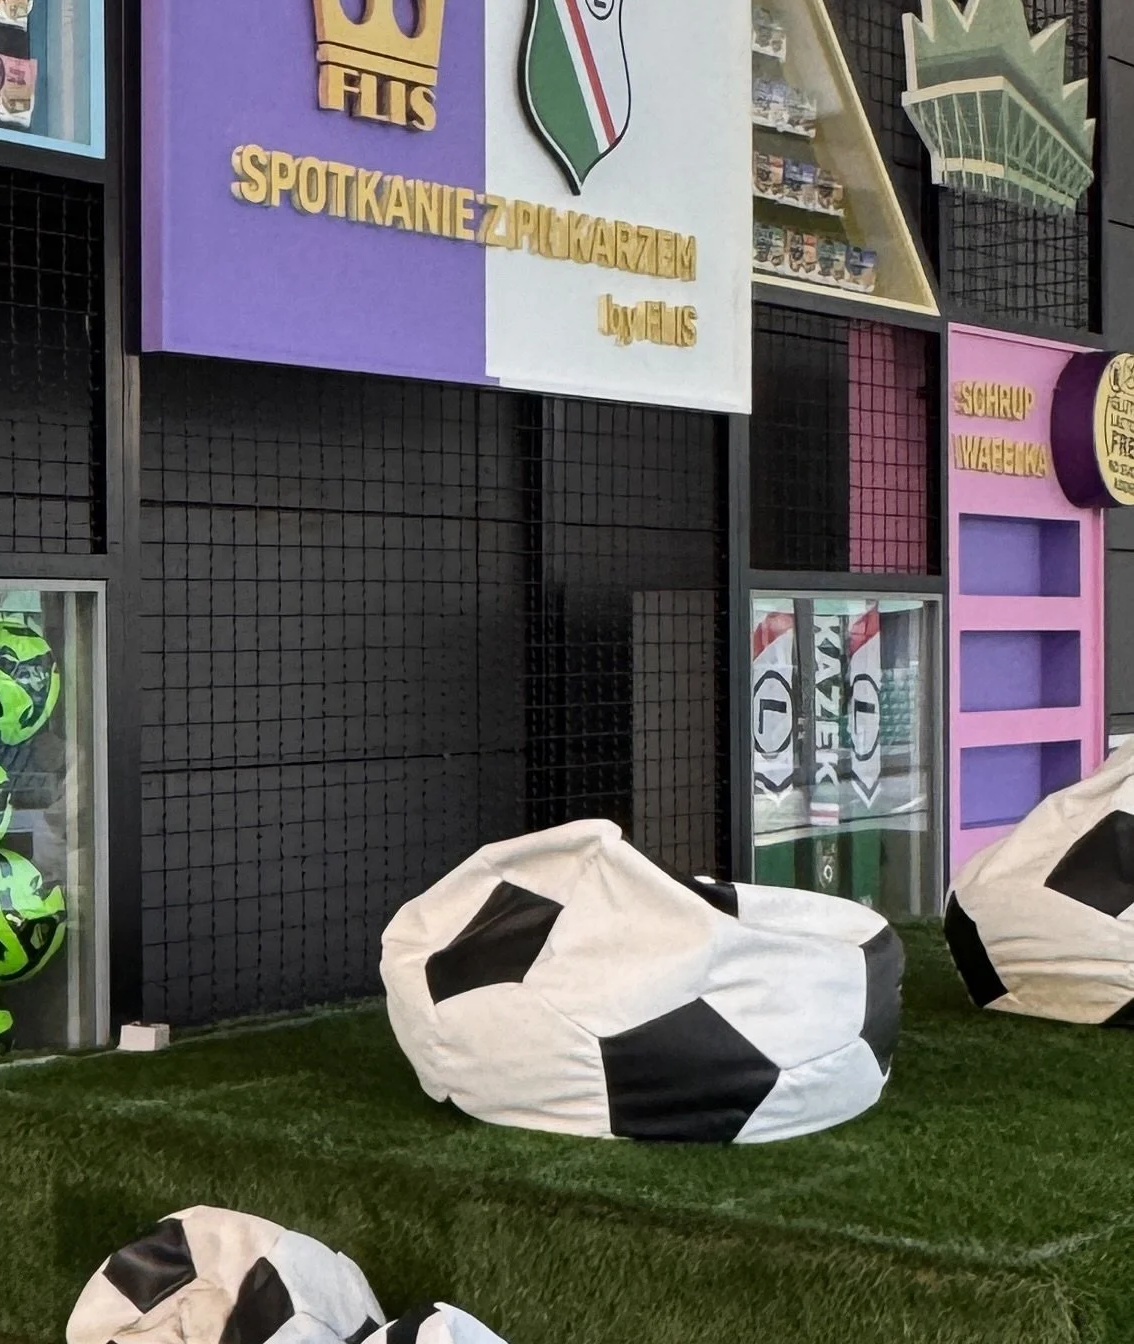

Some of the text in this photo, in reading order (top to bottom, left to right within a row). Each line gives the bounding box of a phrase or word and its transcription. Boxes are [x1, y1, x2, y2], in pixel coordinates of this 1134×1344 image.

[317, 65, 436, 132] FLIS
[231, 143, 478, 244] SPOTKANIE
[477, 193, 511, 249] Z
[598, 294, 634, 346] by
[954, 381, 1036, 421] SCHRUP
[814, 615, 841, 786] KAZEK
